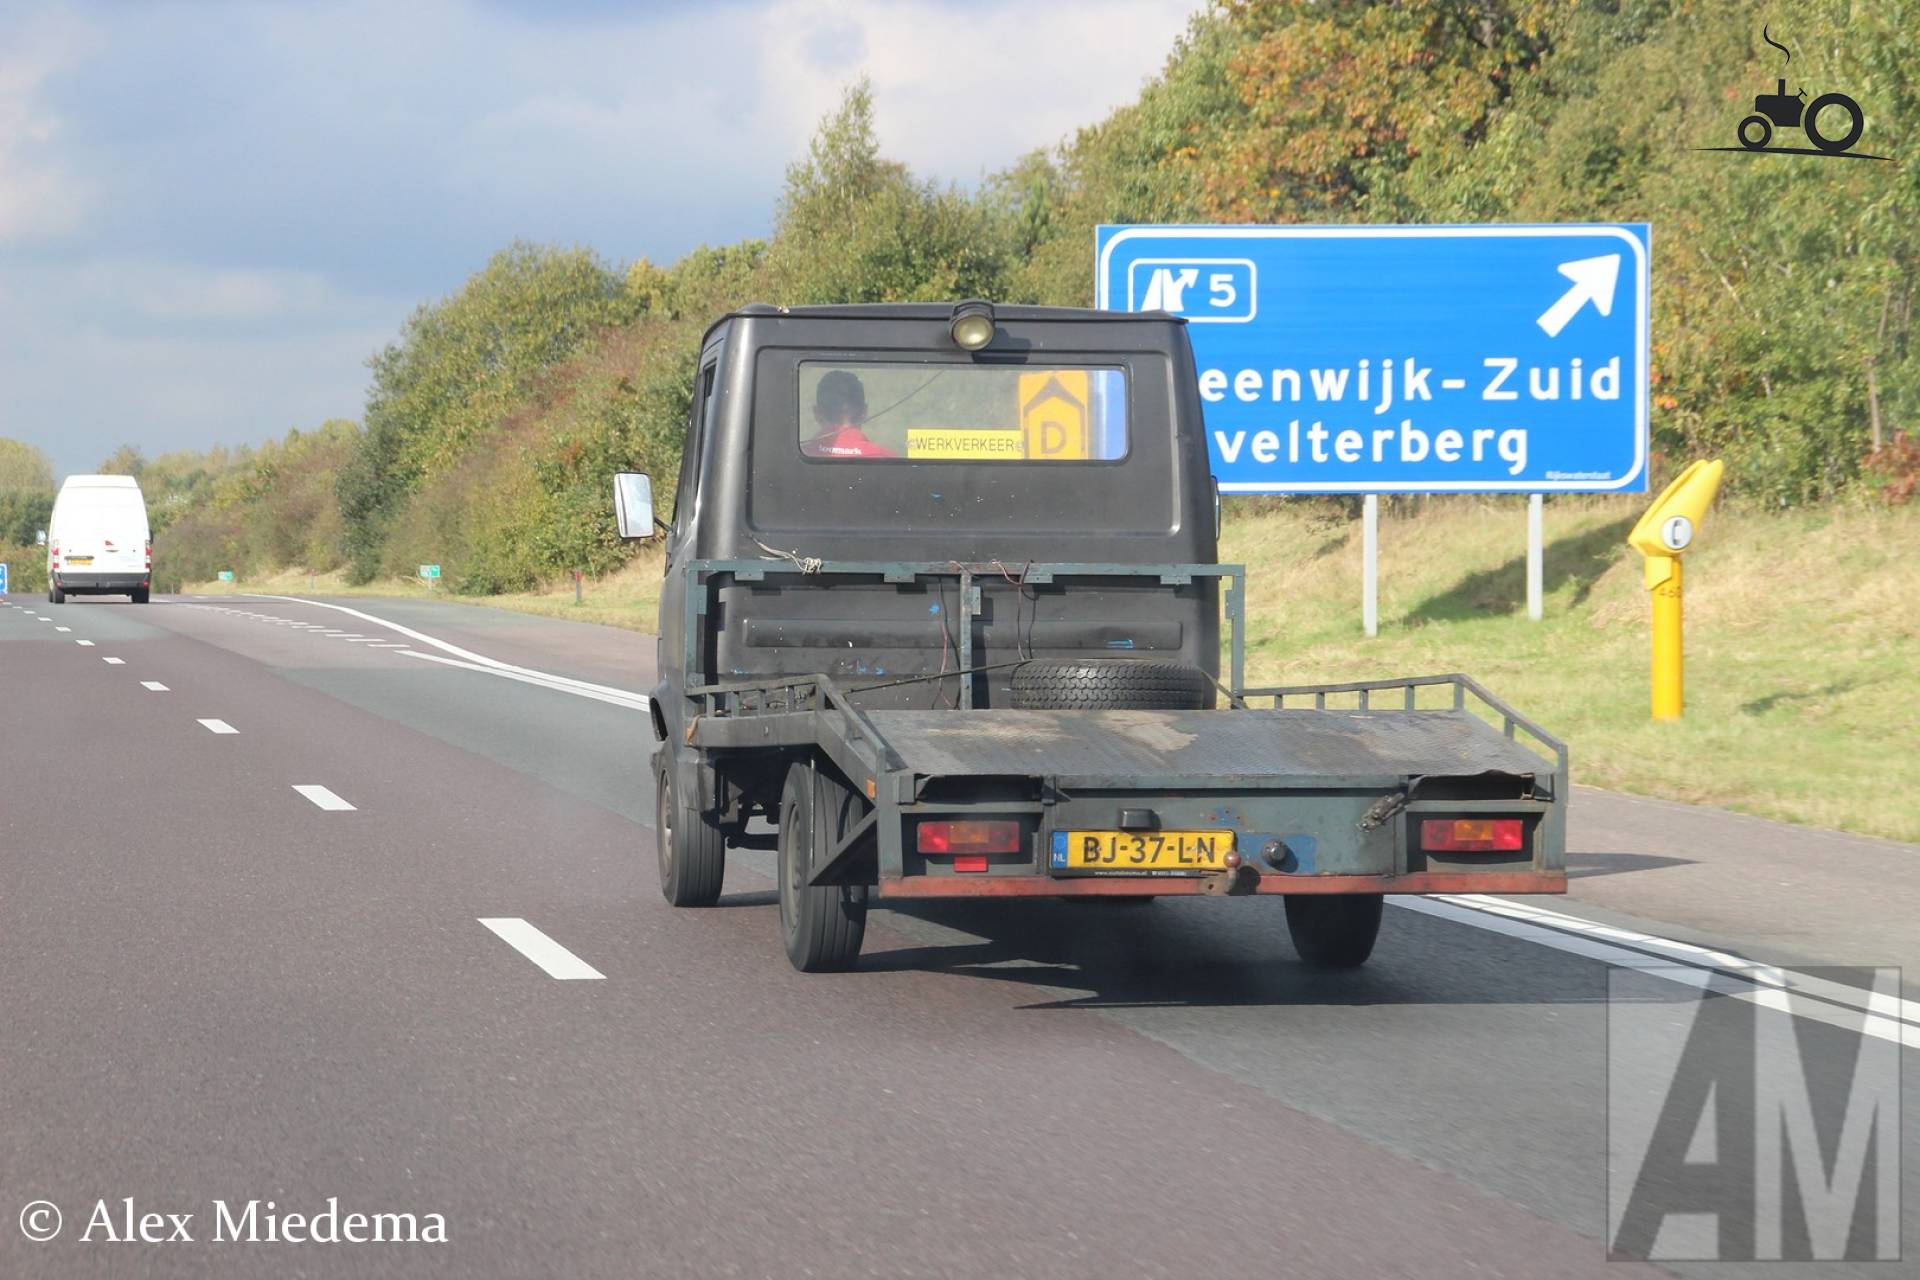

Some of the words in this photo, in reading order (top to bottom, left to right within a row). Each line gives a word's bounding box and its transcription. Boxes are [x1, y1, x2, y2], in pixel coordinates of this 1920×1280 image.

[1208, 273, 1237, 308] 5
[1199, 356, 1620, 415] eenwijk-Zuid
[915, 437, 1015, 453] WERKVERKEER
[1040, 421, 1066, 454] D
[1214, 419, 1528, 476] velterberg
[1053, 853, 1066, 863] NL
[1083, 836, 1215, 864] BJ-37-LN
